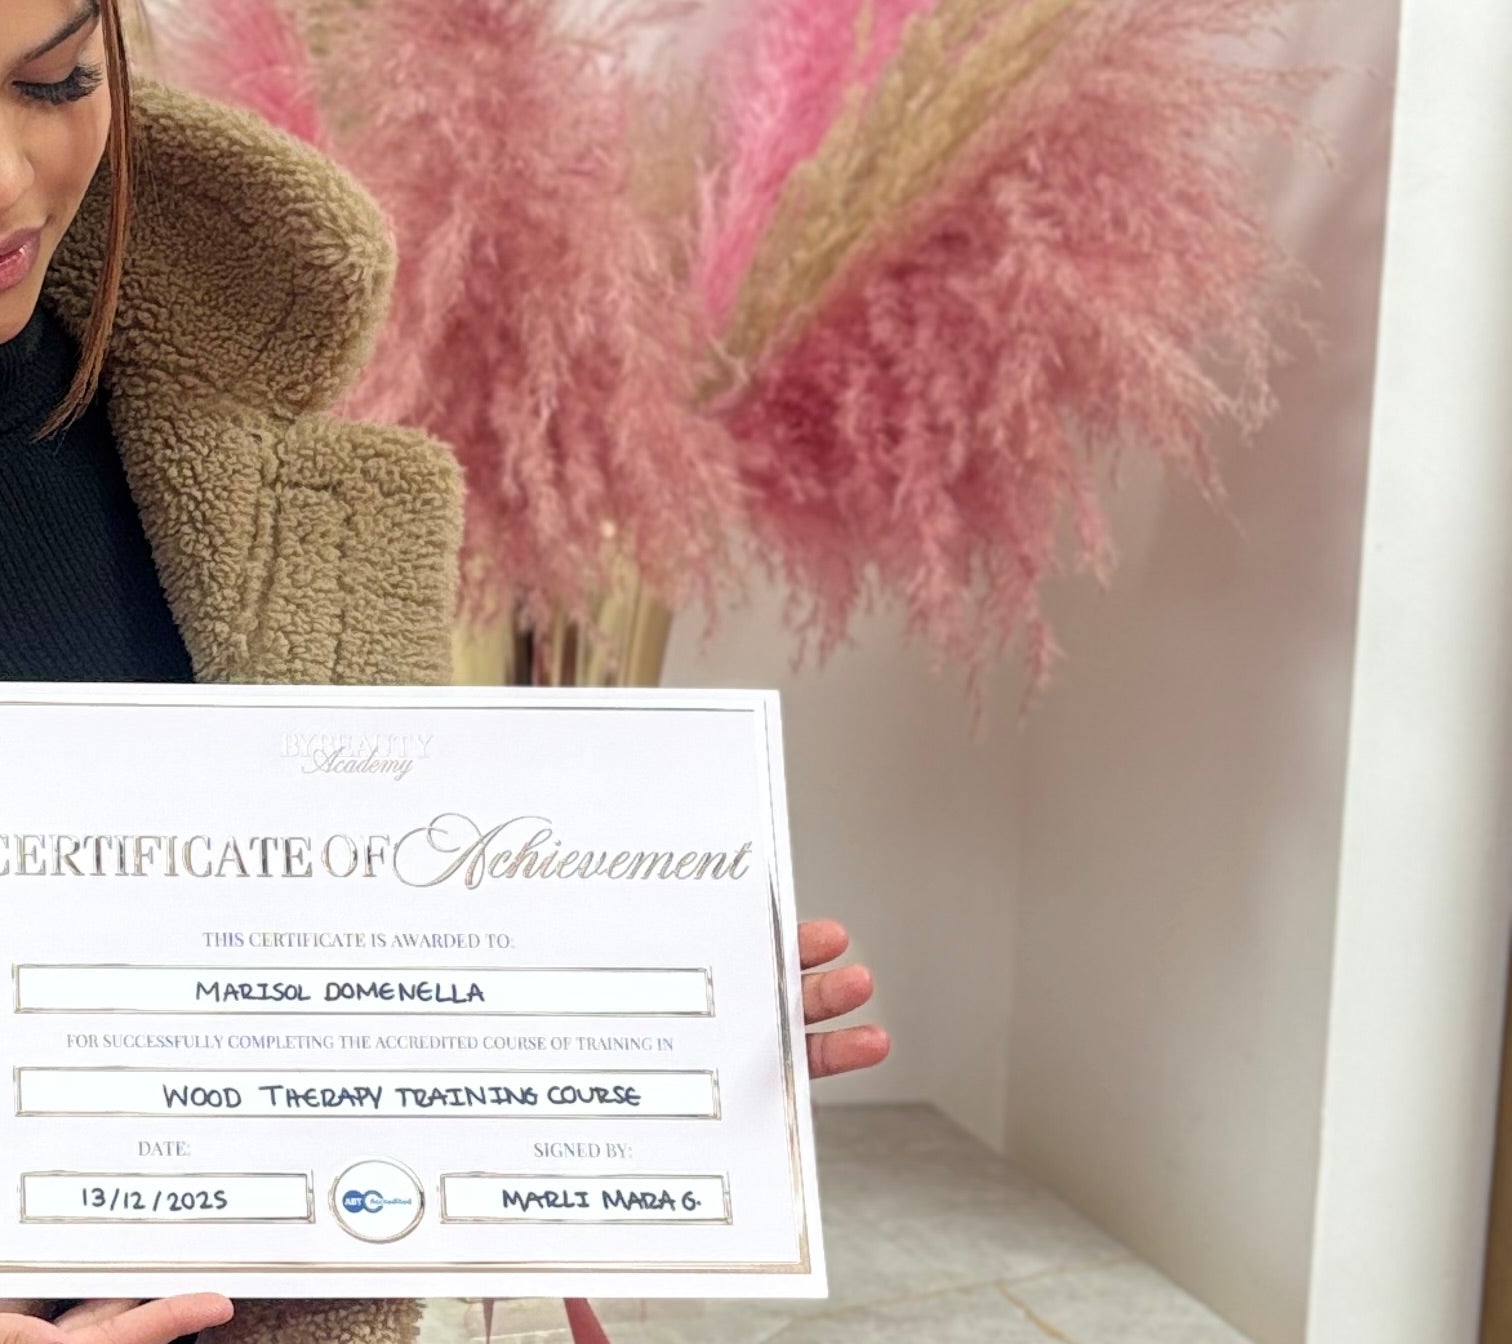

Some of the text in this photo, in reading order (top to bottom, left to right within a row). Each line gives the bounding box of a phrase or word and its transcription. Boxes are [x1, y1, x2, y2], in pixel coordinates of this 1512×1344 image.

[301, 746, 413, 782] Academy
[321, 833, 390, 878] OF
[393, 812, 752, 890] Achievement
[203, 932, 244, 948] THIS
[248, 932, 365, 949] CERTIFICATE
[371, 933, 387, 949] IS
[391, 933, 480, 949] AWARDED
[195, 981, 485, 1003] MARISOL DOMENELLA
[66, 1033, 675, 1052] FOR SUCCESSFULLY COMPLETING THE ACCREDITED COURSE OF TRAINING IN
[162, 1083, 641, 1110] WOOD THERAPY TRAINING COURSE
[138, 1140, 191, 1157] DATE:
[533, 1142, 633, 1159] SIGNED BY:
[82, 1187, 228, 1212] 13/12/2025
[502, 1189, 591, 1212] MARLI
[602, 1189, 676, 1211] MARA
